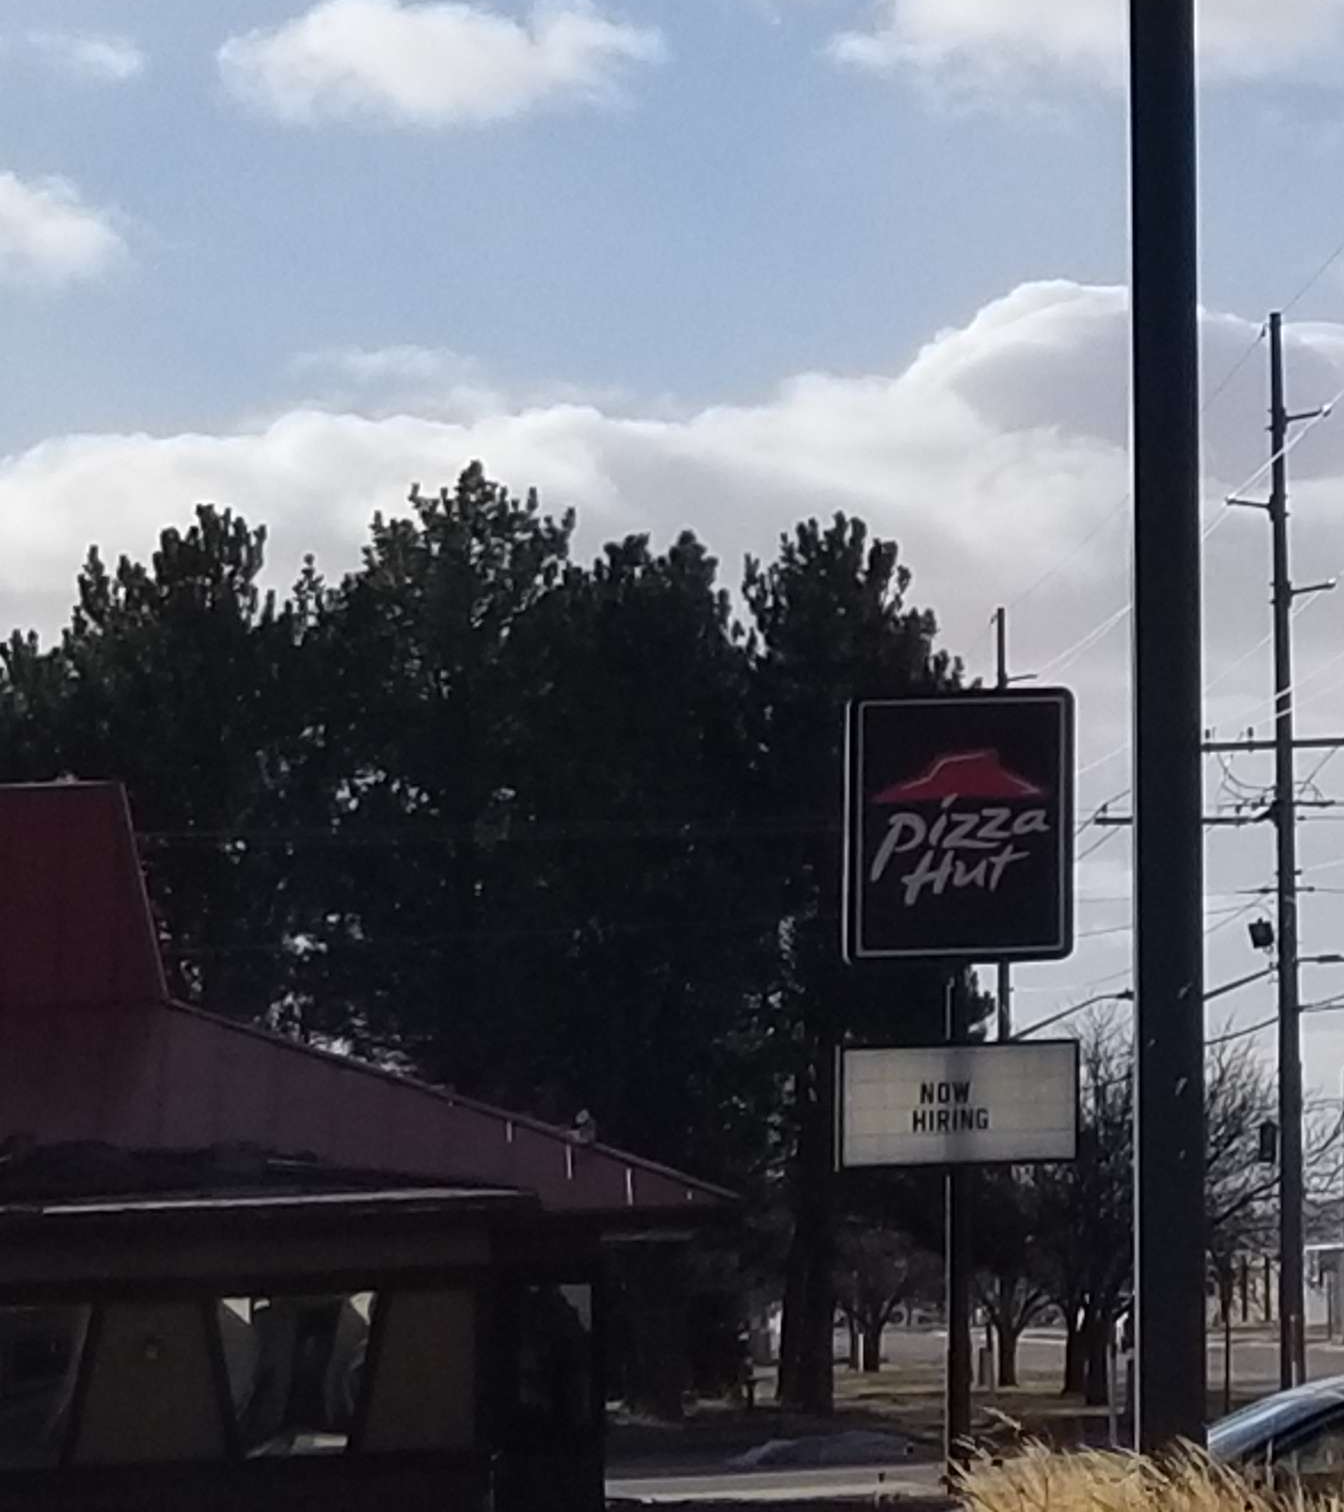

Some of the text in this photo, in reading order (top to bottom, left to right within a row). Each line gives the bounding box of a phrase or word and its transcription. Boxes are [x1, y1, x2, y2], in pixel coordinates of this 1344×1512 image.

[901, 843, 1031, 906] Hut
[919, 1082, 971, 1104] NOW
[911, 1108, 990, 1133] HIRING
